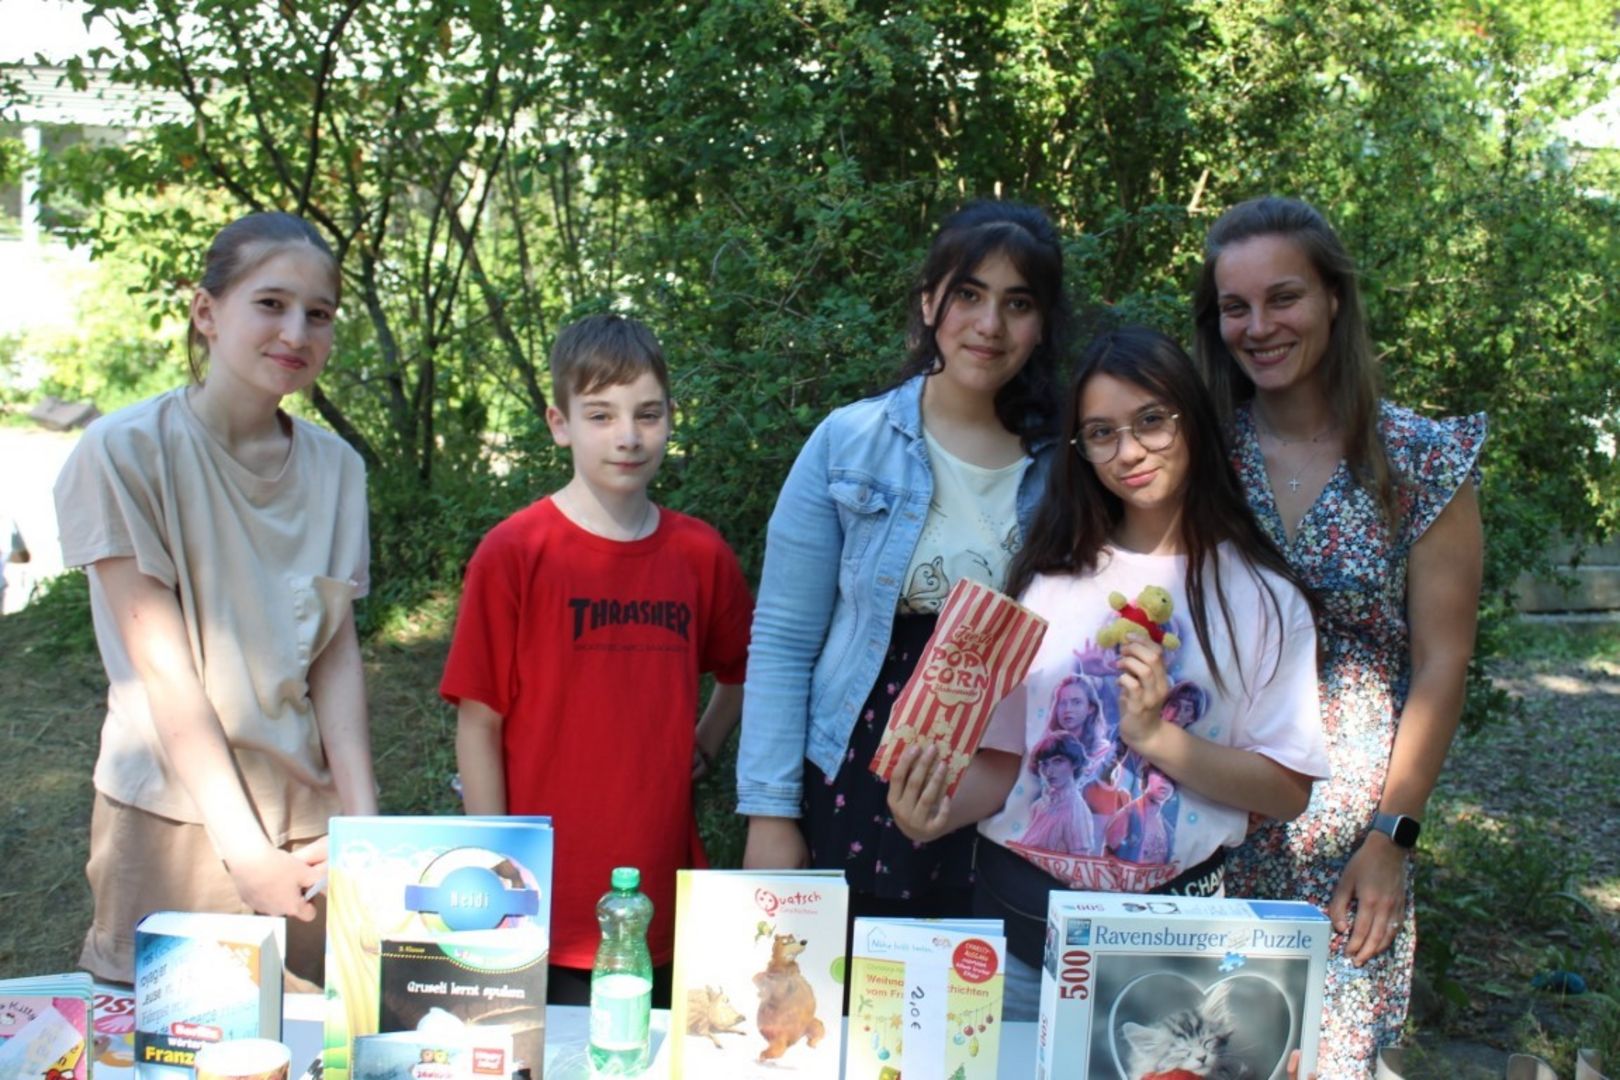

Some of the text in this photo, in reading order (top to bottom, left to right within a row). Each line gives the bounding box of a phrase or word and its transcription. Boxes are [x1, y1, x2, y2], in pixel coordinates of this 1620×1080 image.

[569, 598, 691, 641] THRASHER
[932, 646, 980, 669] POP
[922, 666, 989, 690] CORN
[755, 887, 822, 917] Quatsch
[1095, 925, 1227, 950] Ravensburger
[1252, 928, 1312, 950] Puzzle
[1061, 950, 1092, 1000] 500
[451, 982, 479, 997] lernt
